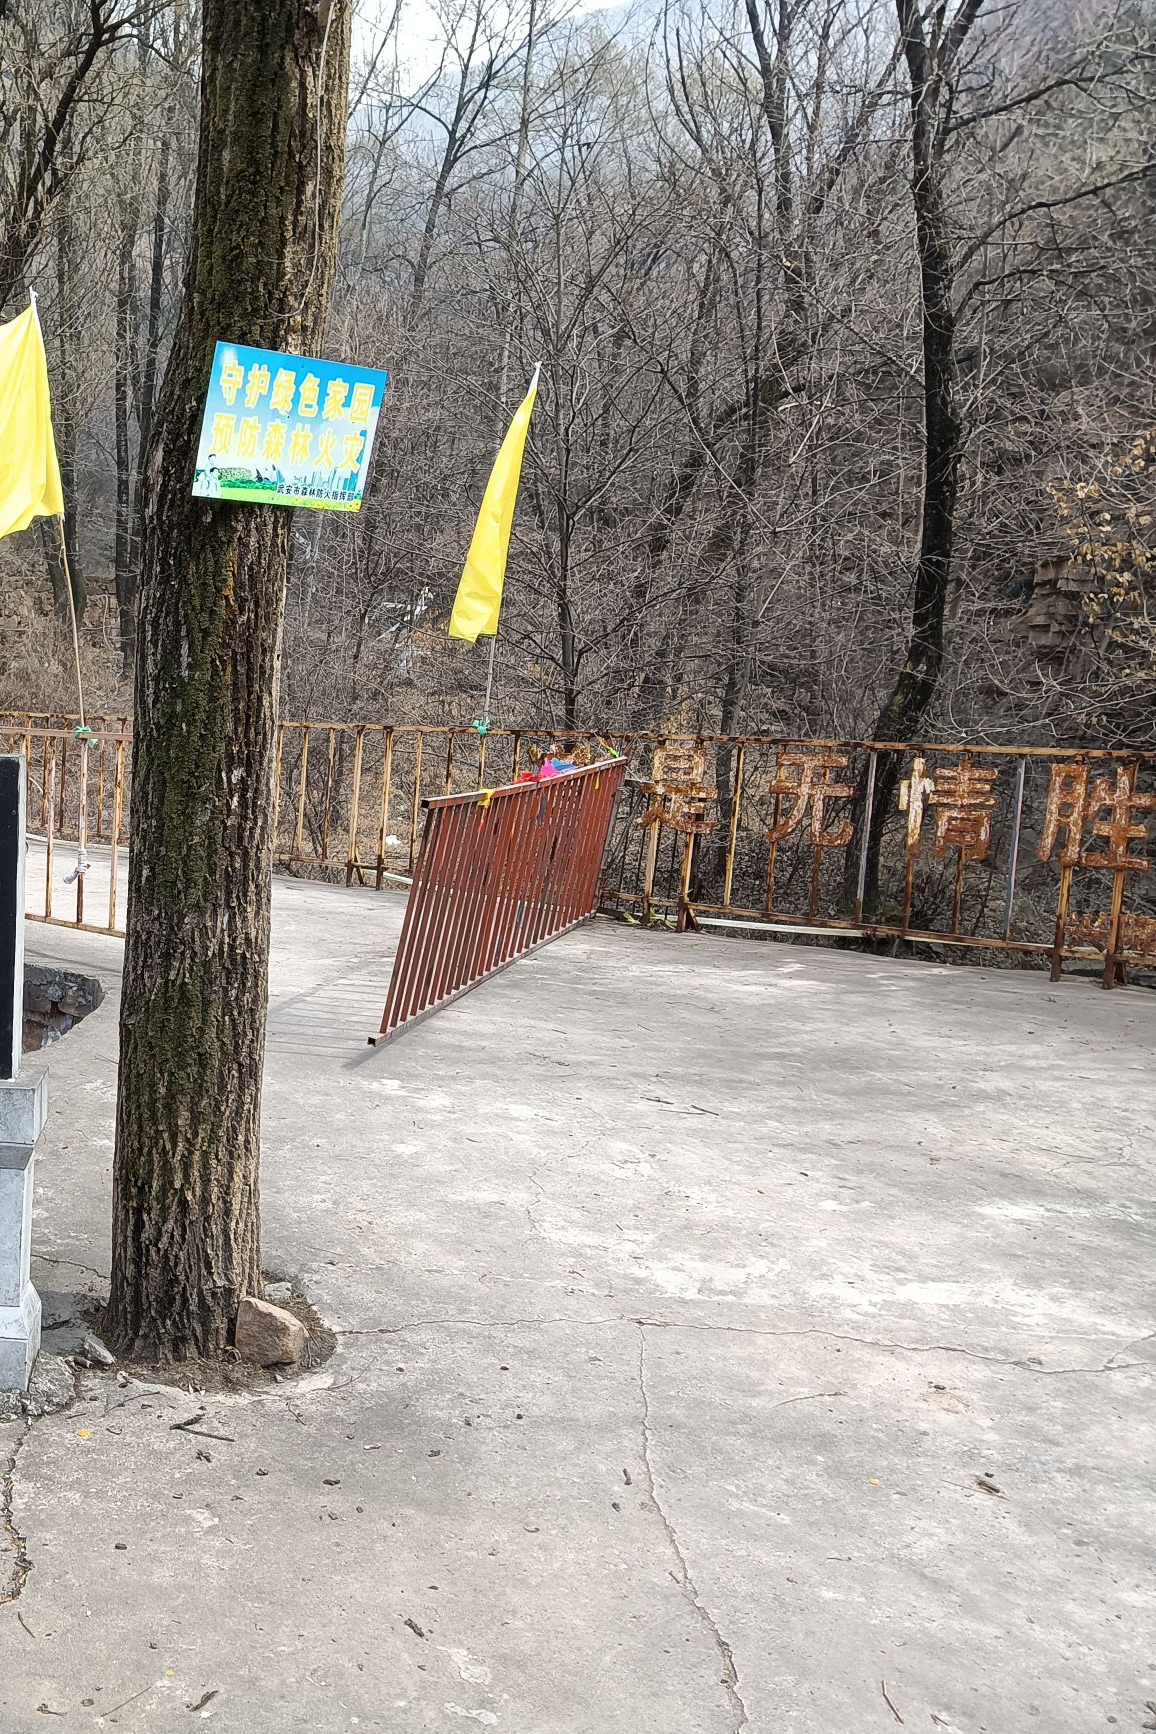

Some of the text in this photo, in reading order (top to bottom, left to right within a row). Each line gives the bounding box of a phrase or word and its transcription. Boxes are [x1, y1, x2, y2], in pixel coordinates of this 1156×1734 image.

[220, 361, 375, 425] 守护绿色家园
[209, 411, 365, 472] 预防森林火灾
[277, 484, 355, 501] 武安市森林防火指挥部
